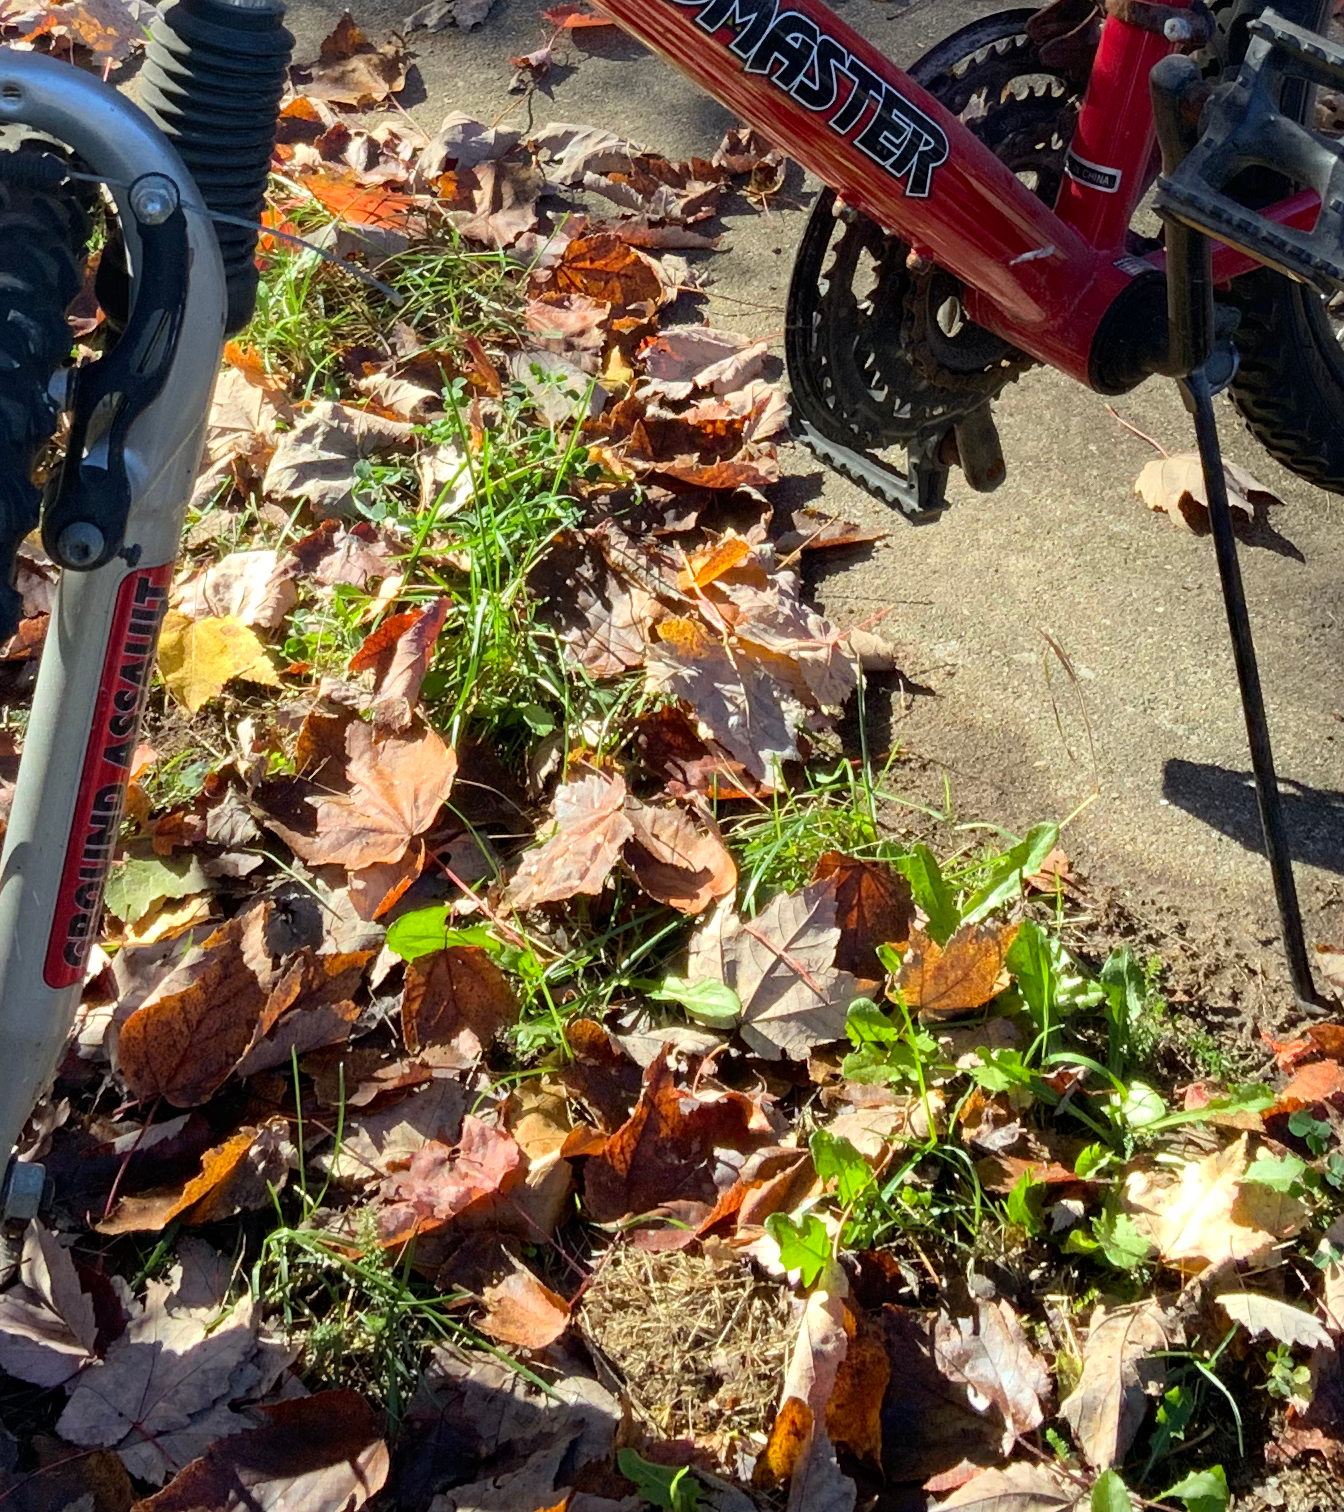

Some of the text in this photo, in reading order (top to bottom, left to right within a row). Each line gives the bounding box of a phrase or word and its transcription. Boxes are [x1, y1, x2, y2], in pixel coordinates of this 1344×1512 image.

[1082, 169, 1110, 186] CHINA
[62, 575, 169, 969] GROUND ASSAULT
